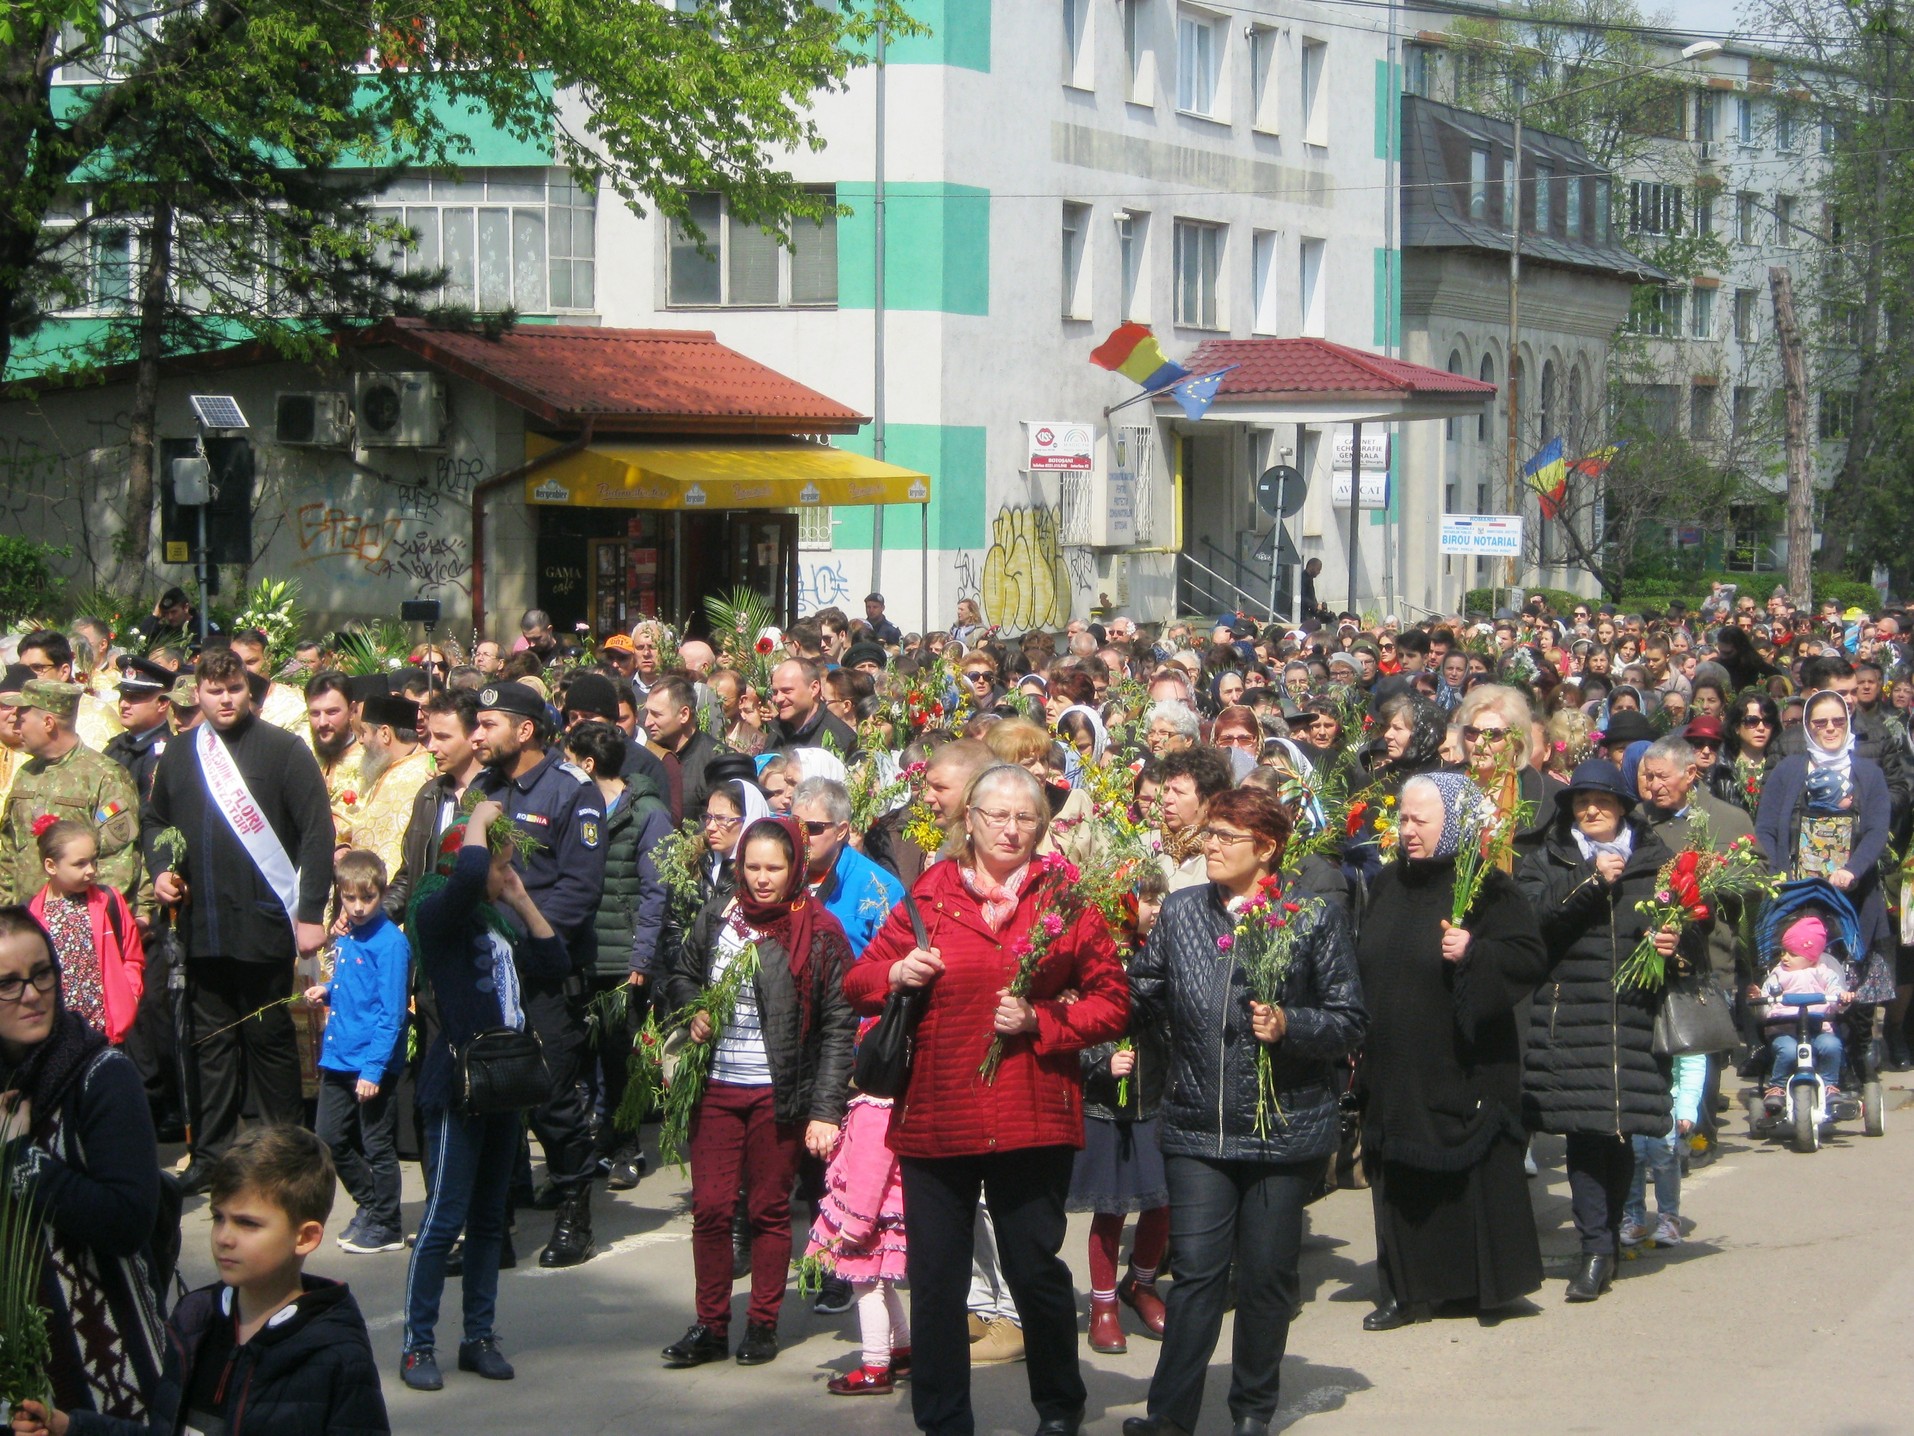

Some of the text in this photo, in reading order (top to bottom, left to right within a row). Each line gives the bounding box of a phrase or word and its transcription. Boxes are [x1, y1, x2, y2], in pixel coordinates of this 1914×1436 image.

[1337, 486, 1381, 494] AVCAT
[1442, 535, 1517, 547] BIROU NOTARIAL
[546, 566, 581, 578] GAMA
[202, 753, 250, 835] ORGANIZATORI
[233, 788, 265, 834] FLORII
